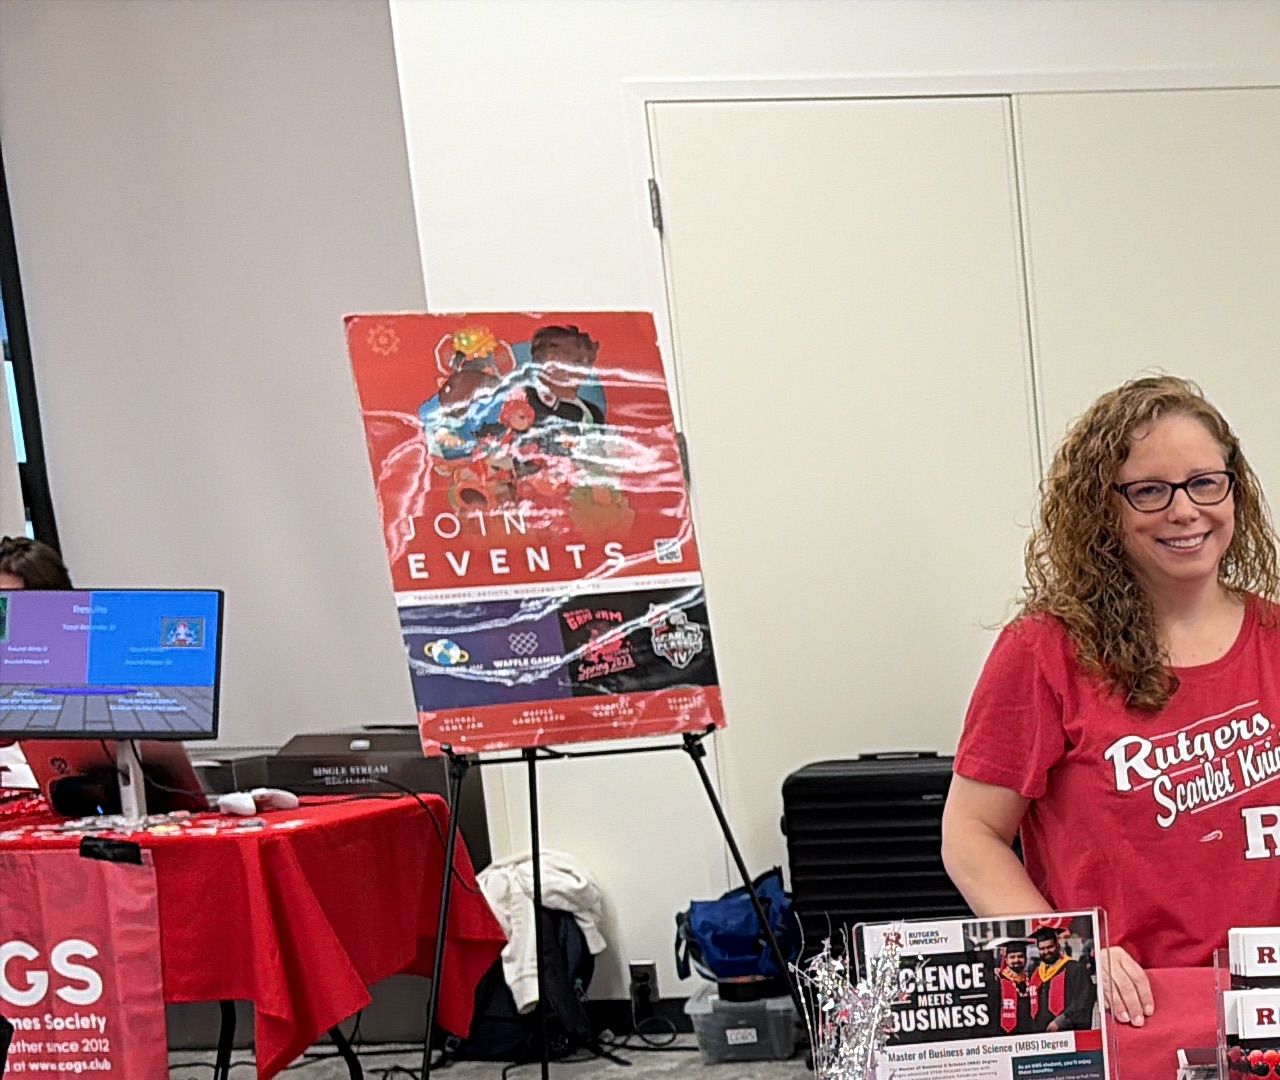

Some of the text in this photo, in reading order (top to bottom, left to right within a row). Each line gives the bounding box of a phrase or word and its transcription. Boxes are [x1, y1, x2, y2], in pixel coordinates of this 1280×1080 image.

[404, 511, 526, 540] JOIN
[408, 543, 624, 579] EVENTS
[494, 658, 529, 667] WAFFLE
[579, 663, 609, 679] Spring
[1104, 713, 1270, 792] Rutgers
[350, 765, 388, 774] STREAM
[1153, 758, 1235, 828] Scarlet
[909, 937, 948, 945] UNIVERSITY
[1257, 946, 1277, 964] R
[0, 939, 103, 1007] GS
[899, 962, 986, 993] CIENCE
[918, 993, 953, 1007] MEETS
[12, 1013, 106, 1034] mes Society
[891, 1004, 989, 1032] BUSINESS
[1256, 1008, 1277, 1026] R
[8, 1039, 109, 1054] ether since 2012
[888, 1039, 1068, 1063] Master of Business and Science (MBS) Degree
